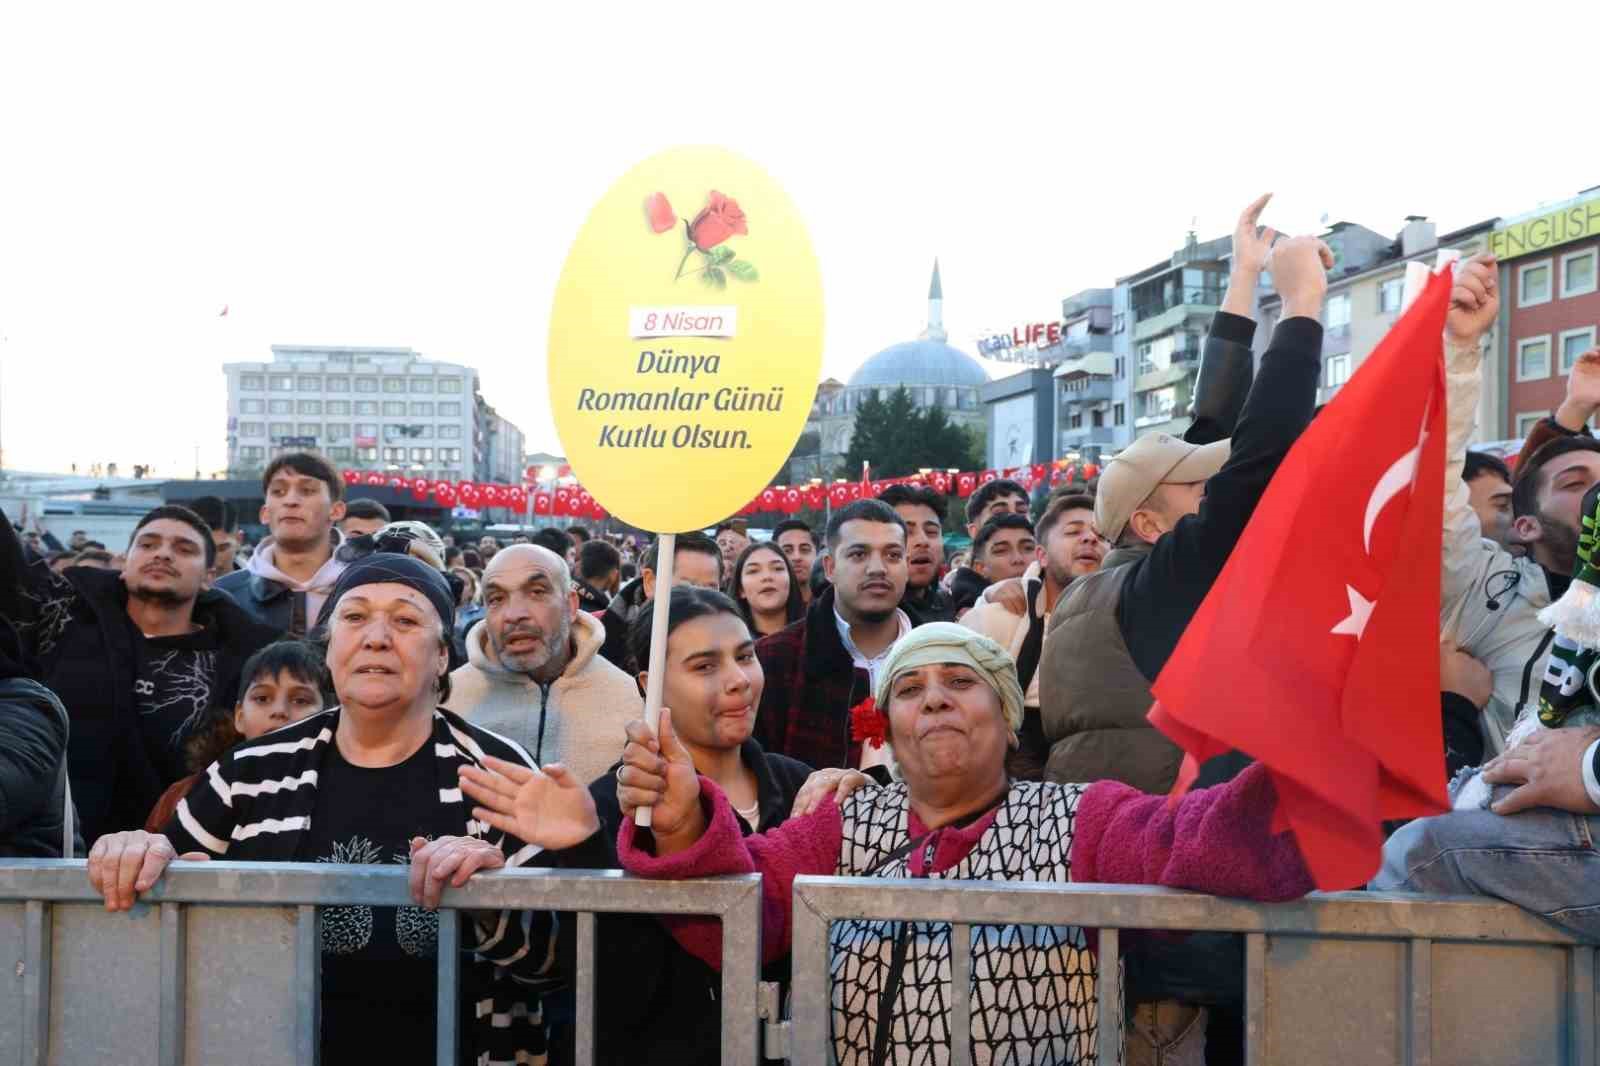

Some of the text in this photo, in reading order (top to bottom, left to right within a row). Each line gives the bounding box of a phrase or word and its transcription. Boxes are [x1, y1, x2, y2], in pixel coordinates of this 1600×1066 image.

[643, 311, 723, 331] 8 Nisan
[636, 349, 721, 379] Dünya
[577, 386, 784, 412] Romanlar Günü
[598, 424, 753, 449] Kutlu Olsun.
